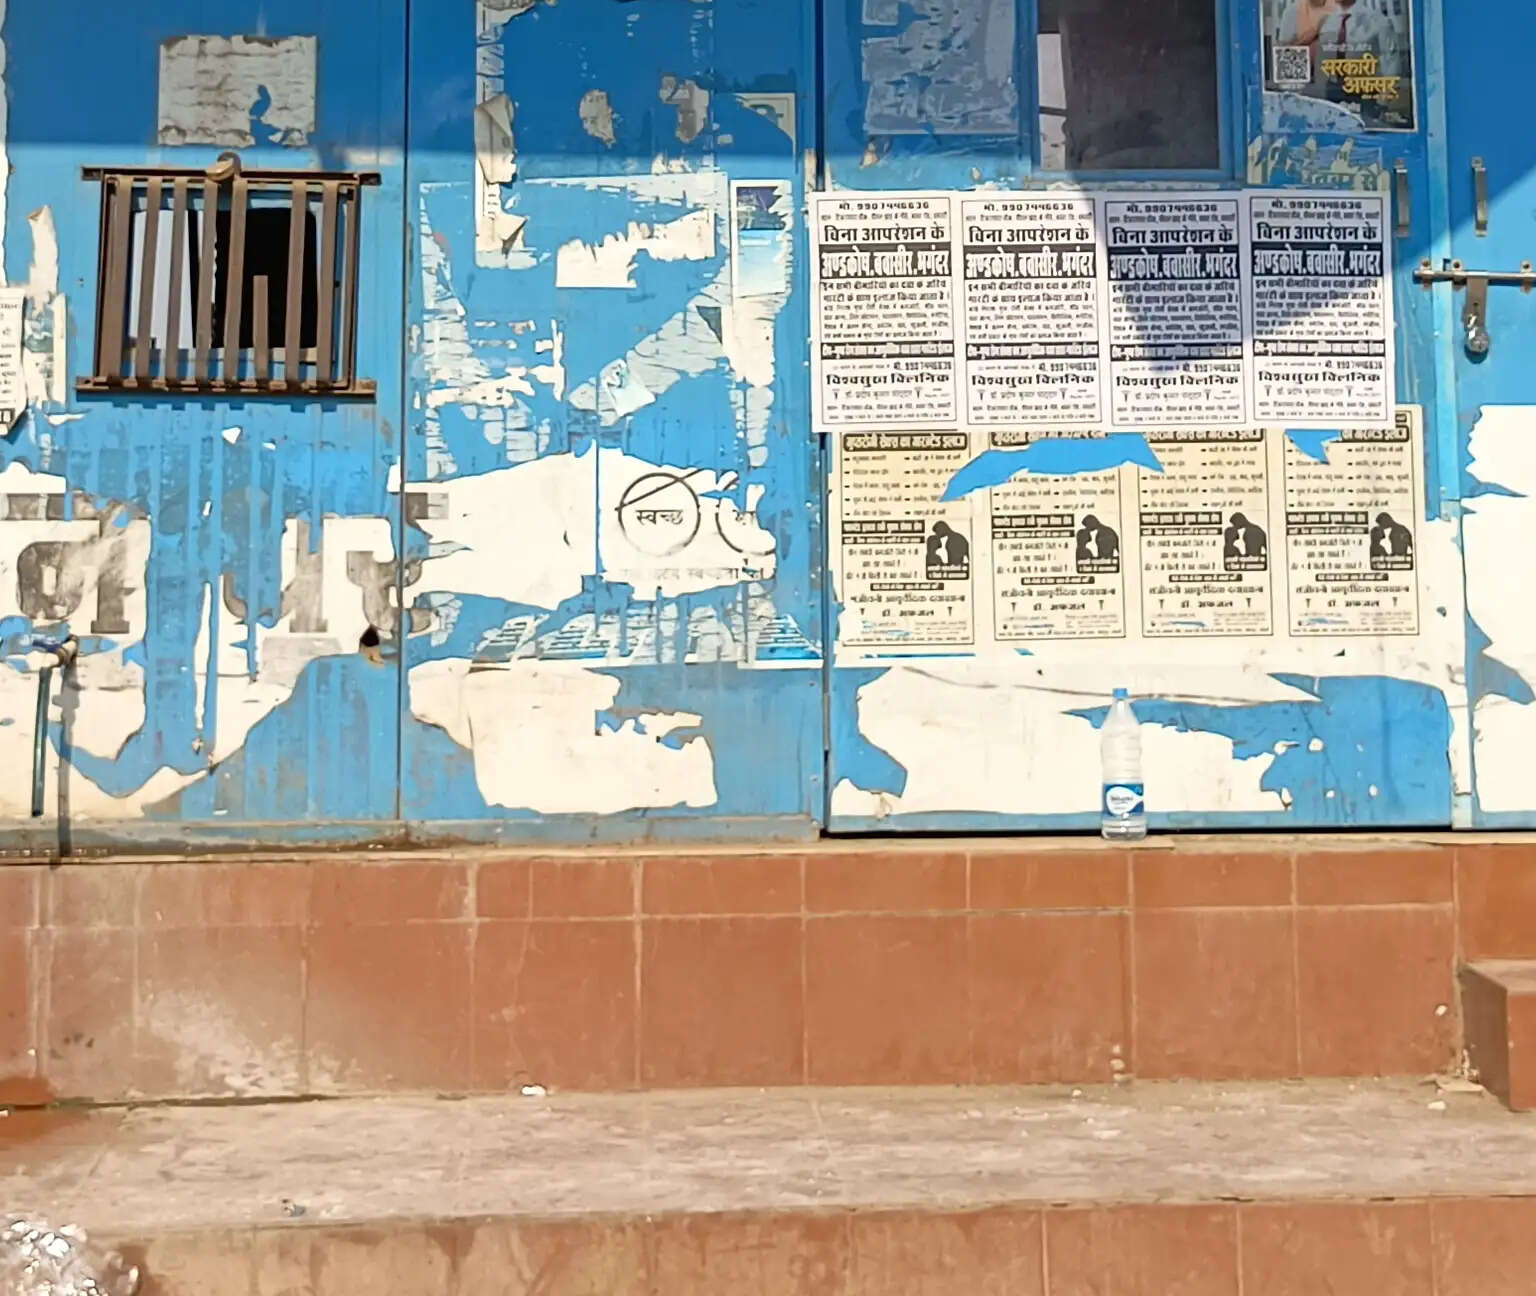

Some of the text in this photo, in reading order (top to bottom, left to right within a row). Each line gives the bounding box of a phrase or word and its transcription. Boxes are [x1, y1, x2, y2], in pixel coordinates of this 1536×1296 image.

[1321, 53, 1378, 76] सरकारी
[1341, 76, 1400, 94] अफसर
[931, 220, 945, 239] के
[1075, 221, 1090, 240] के
[1218, 222, 1233, 242] के
[1363, 220, 1378, 239] के
[635, 509, 684, 525] स्वच्छ
